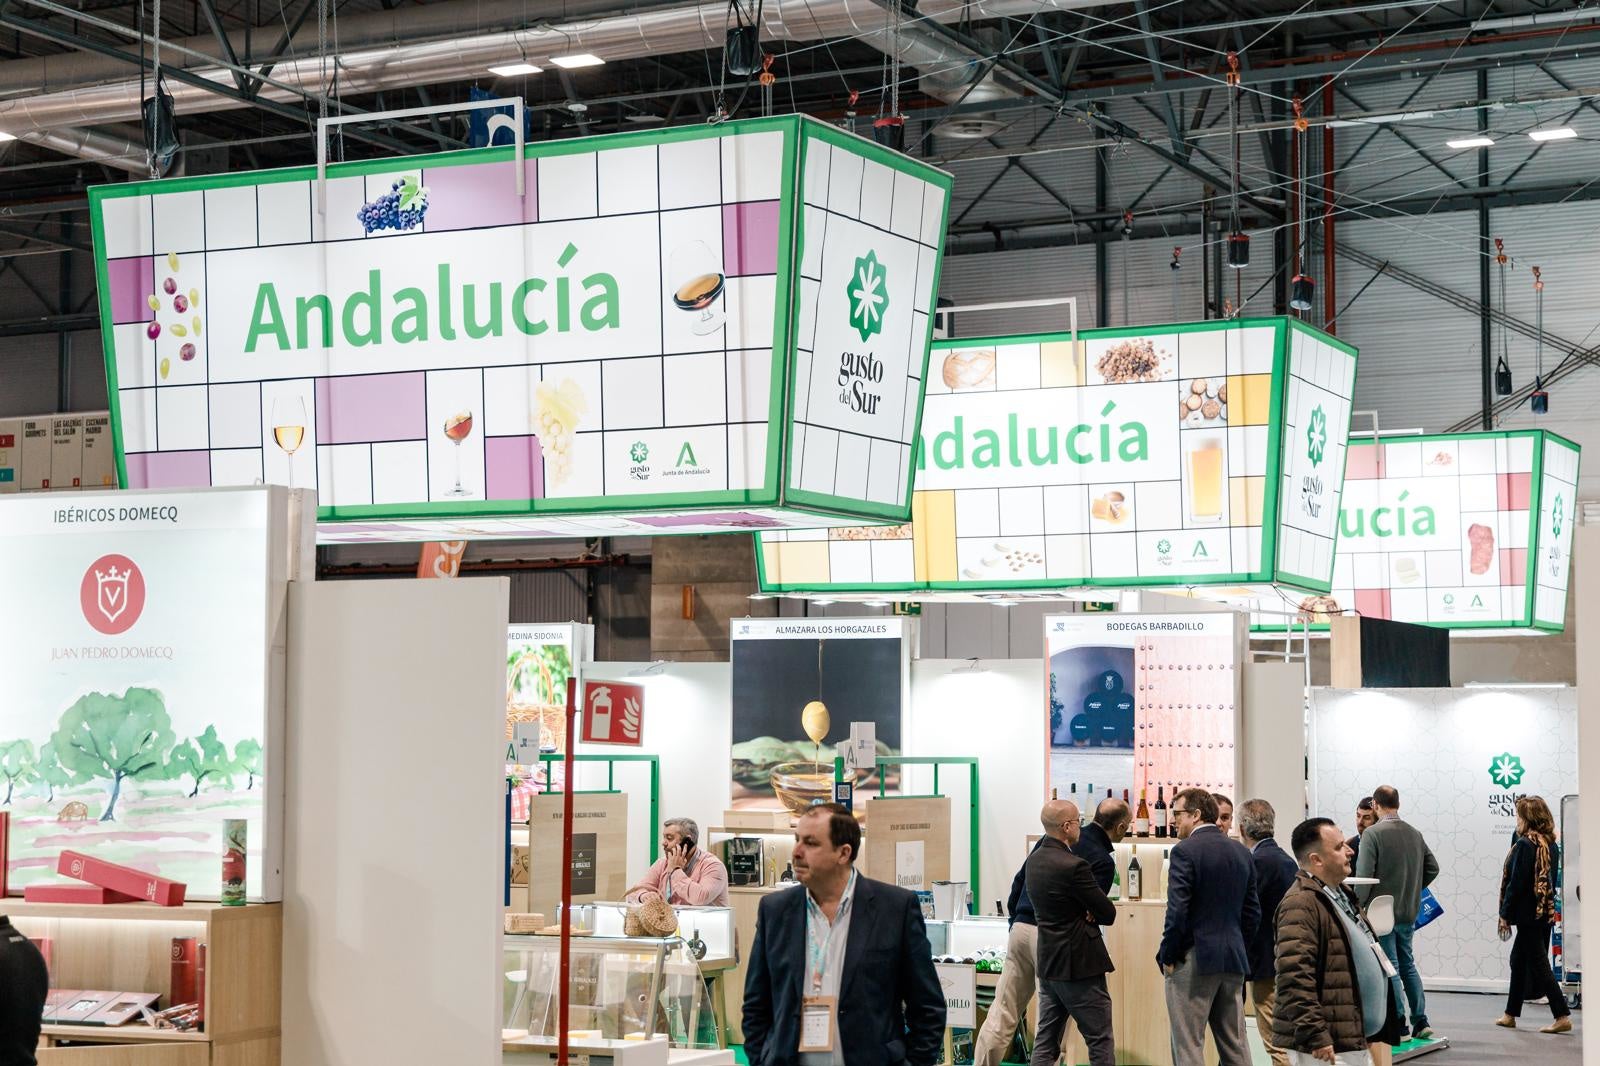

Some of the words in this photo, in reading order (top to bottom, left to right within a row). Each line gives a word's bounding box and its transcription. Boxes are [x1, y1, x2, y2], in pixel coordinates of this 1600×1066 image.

[244, 241, 620, 352] Andalucía
[838, 351, 883, 387] gusto
[839, 388, 851, 405] del
[851, 380, 881, 415] Sur
[54, 506, 115, 523] IBÉRICOS
[119, 506, 178, 522] DOMECQ
[1340, 490, 1435, 538] ucía
[775, 626, 816, 634] ALMAZARA
[818, 626, 833, 634] LOS
[835, 625, 887, 633] HORGAZALES
[1106, 622, 1147, 631] BODEGAS
[1149, 622, 1204, 631] BARBADILLO
[534, 632, 564, 640] SIDONIA
[82, 647, 118, 659] PEDRO
[121, 646, 173, 660] DOMECQ
